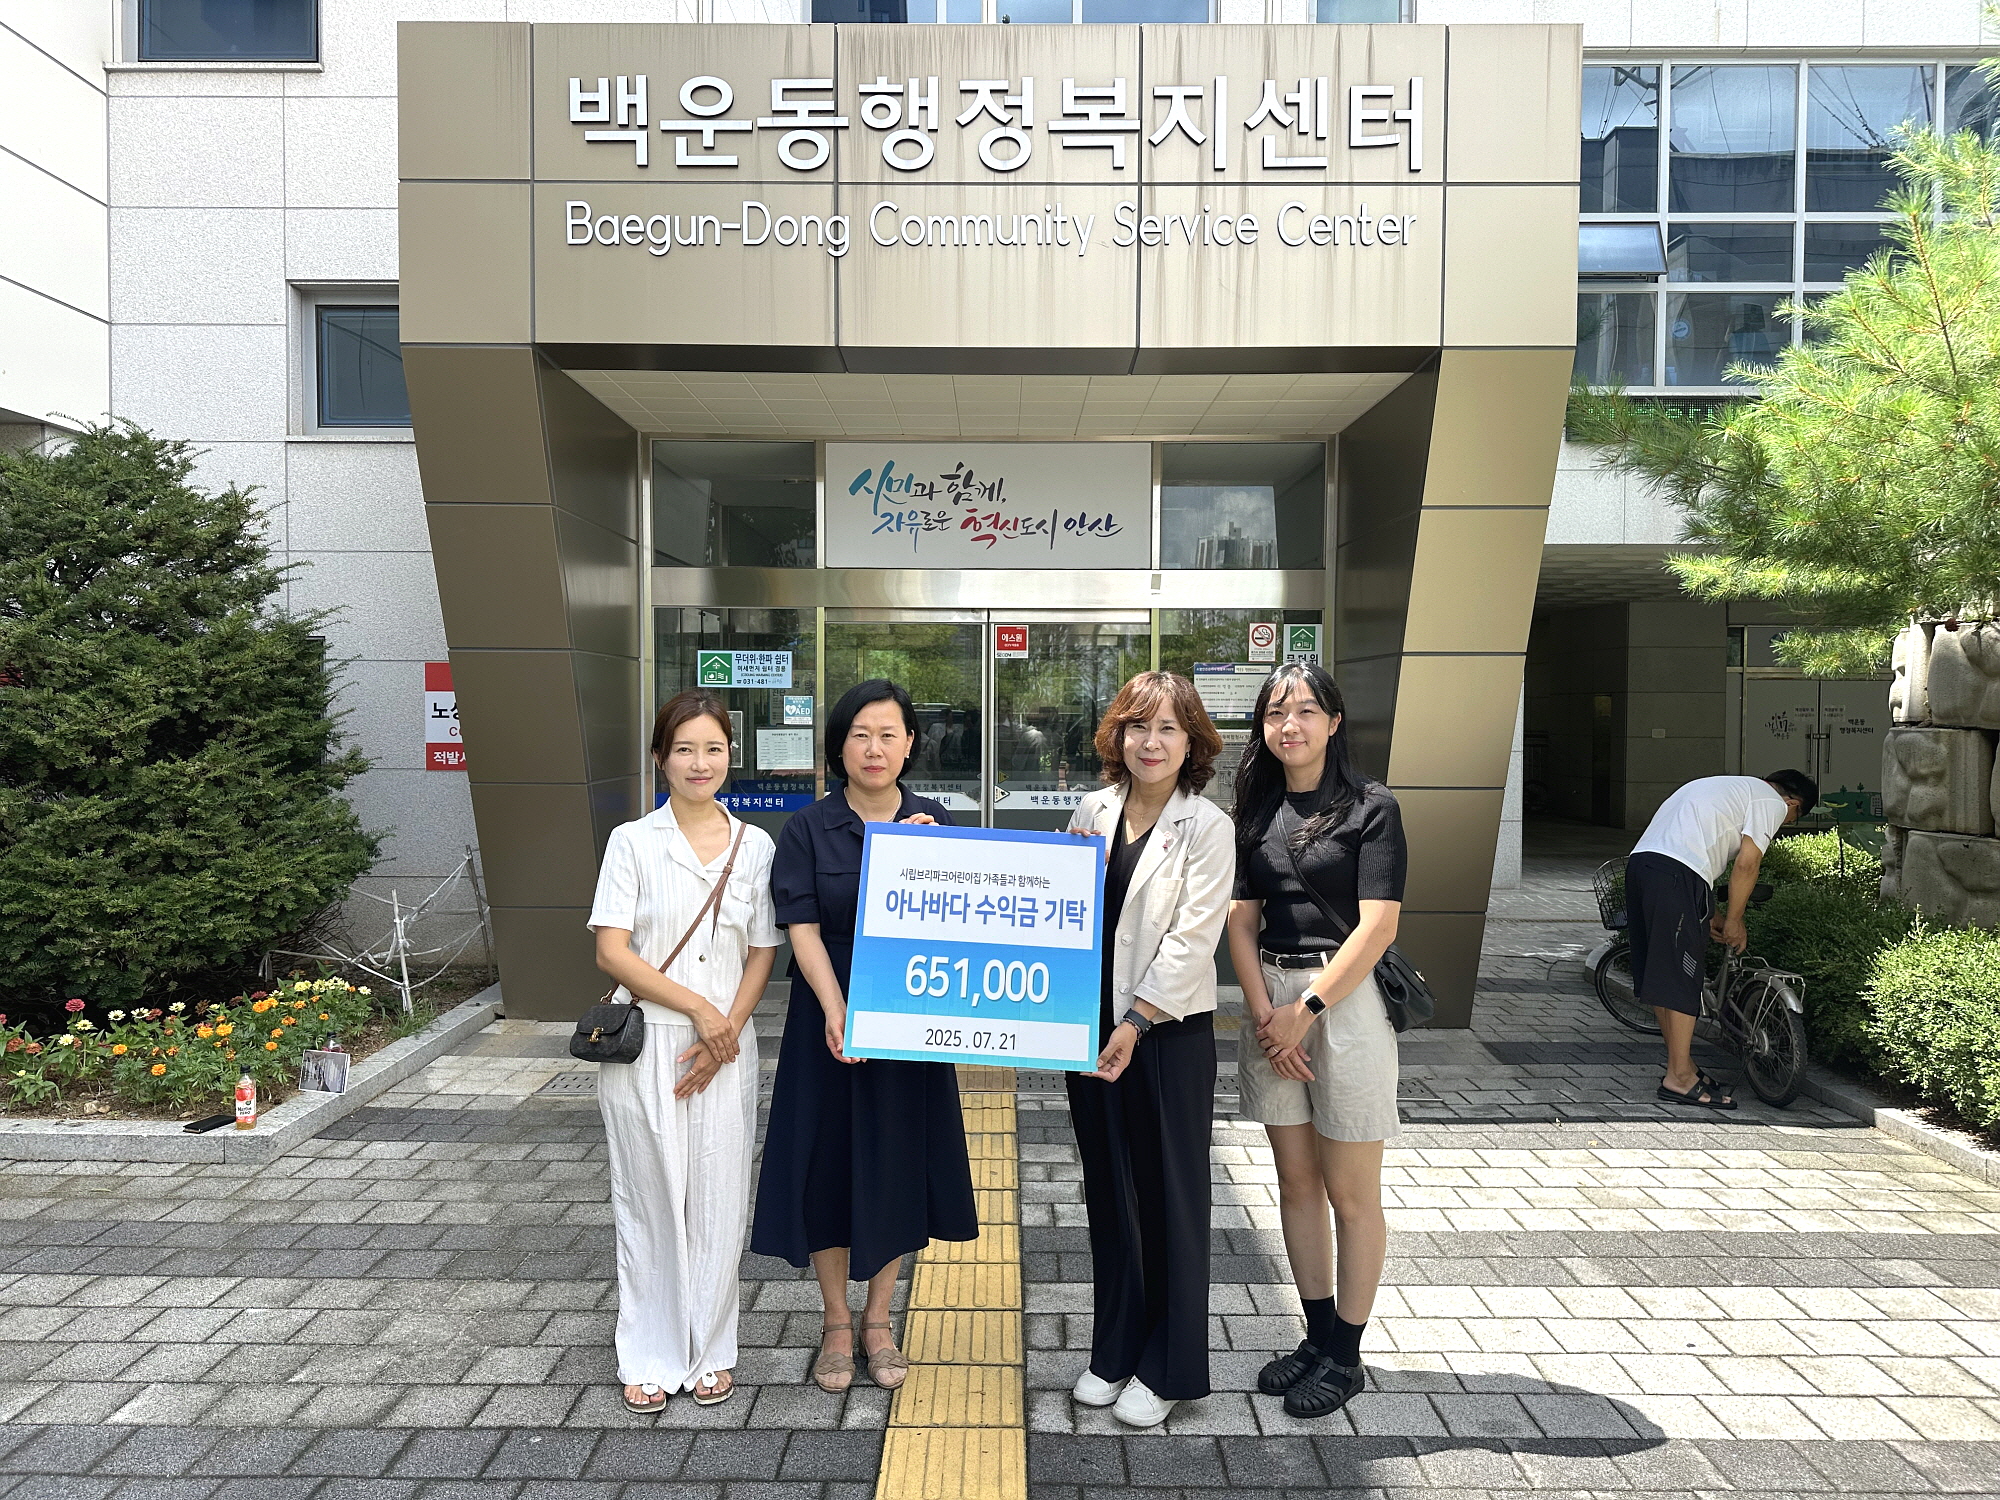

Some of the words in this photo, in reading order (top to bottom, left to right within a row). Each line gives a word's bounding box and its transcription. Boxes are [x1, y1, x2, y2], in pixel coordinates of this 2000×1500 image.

[568, 74, 1424, 171] 백운동행정복지센터
[565, 200, 850, 257] Baegun-Dong
[869, 200, 1096, 257] Community
[1113, 200, 1259, 247] Service
[1277, 200, 1417, 247] Center
[849, 460, 942, 516] 시민과
[872, 509, 953, 553] 자유로운
[960, 508, 1058, 550] 혁신도시
[1064, 511, 1124, 538] 안산
[774, 653, 789, 665] 쉼터
[1001, 633, 1022, 642] 에스원
[449, 727, 462, 736] C
[713, 797, 784, 807] 행정복지센터
[900, 868, 982, 886] 시립브리파크어린이집
[983, 872, 1017, 887] 가족들과
[1018, 875, 1051, 889] 함께하는
[886, 888, 971, 924] 아나바다
[974, 893, 1039, 928] 수익금
[1044, 898, 1087, 931] 기탁
[905, 954, 1051, 1008] 651,000
